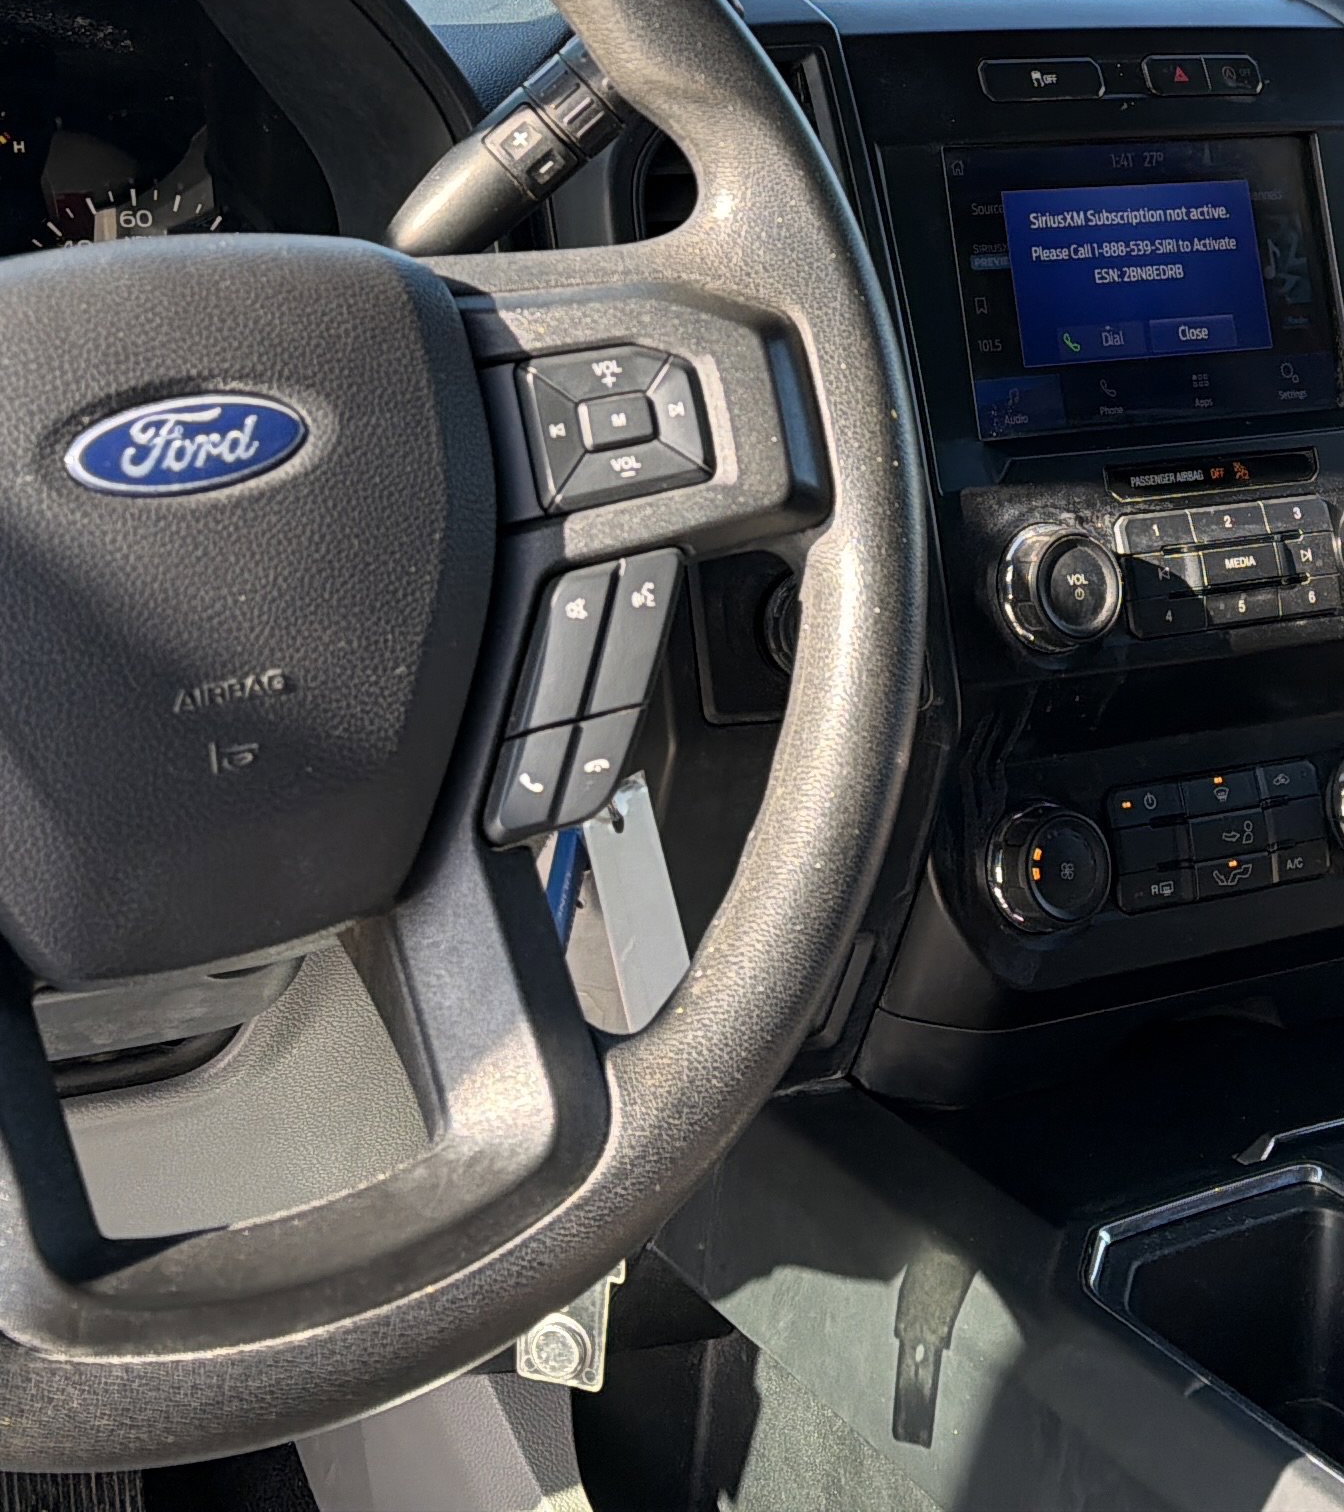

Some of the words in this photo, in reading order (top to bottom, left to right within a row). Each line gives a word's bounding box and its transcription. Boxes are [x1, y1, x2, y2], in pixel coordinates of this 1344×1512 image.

[12, 140, 26, 154] H
[119, 209, 153, 228] 60
[1029, 210, 1085, 229] SiriusXM
[1086, 207, 1165, 227] Subscription
[1166, 205, 1189, 222] not
[1189, 203, 1231, 221] active.
[1031, 245, 1069, 261] Please
[1070, 243, 1092, 259] Call
[1178, 238, 1191, 252] to
[1193, 236, 1237, 252] Activate
[1094, 268, 1121, 284] ESN:
[1101, 330, 1125, 347] Dial
[1178, 325, 1209, 341] Close
[591, 359, 623, 377] VOL
[1194, 397, 1213, 408] Apps
[1099, 405, 1124, 416] Phone
[610, 412, 627, 427] M
[120, 407, 259, 478] Ford
[609, 455, 642, 472] VOL
[1130, 472, 1176, 488] PASSENGER
[1176, 469, 1204, 482] AIRBAG
[1210, 467, 1225, 479] OFF
[1292, 506, 1302, 520] 3
[1223, 514, 1233, 528] 2
[1152, 523, 1160, 537] 1
[1224, 555, 1256, 570] MEDIA
[1066, 573, 1089, 586] VOL
[1308, 590, 1316, 604] 6
[1238, 599, 1246, 613] 5
[1165, 609, 1173, 623] 4
[172, 668, 285, 714] AIRBAG
[1286, 857, 1304, 870] A/C
